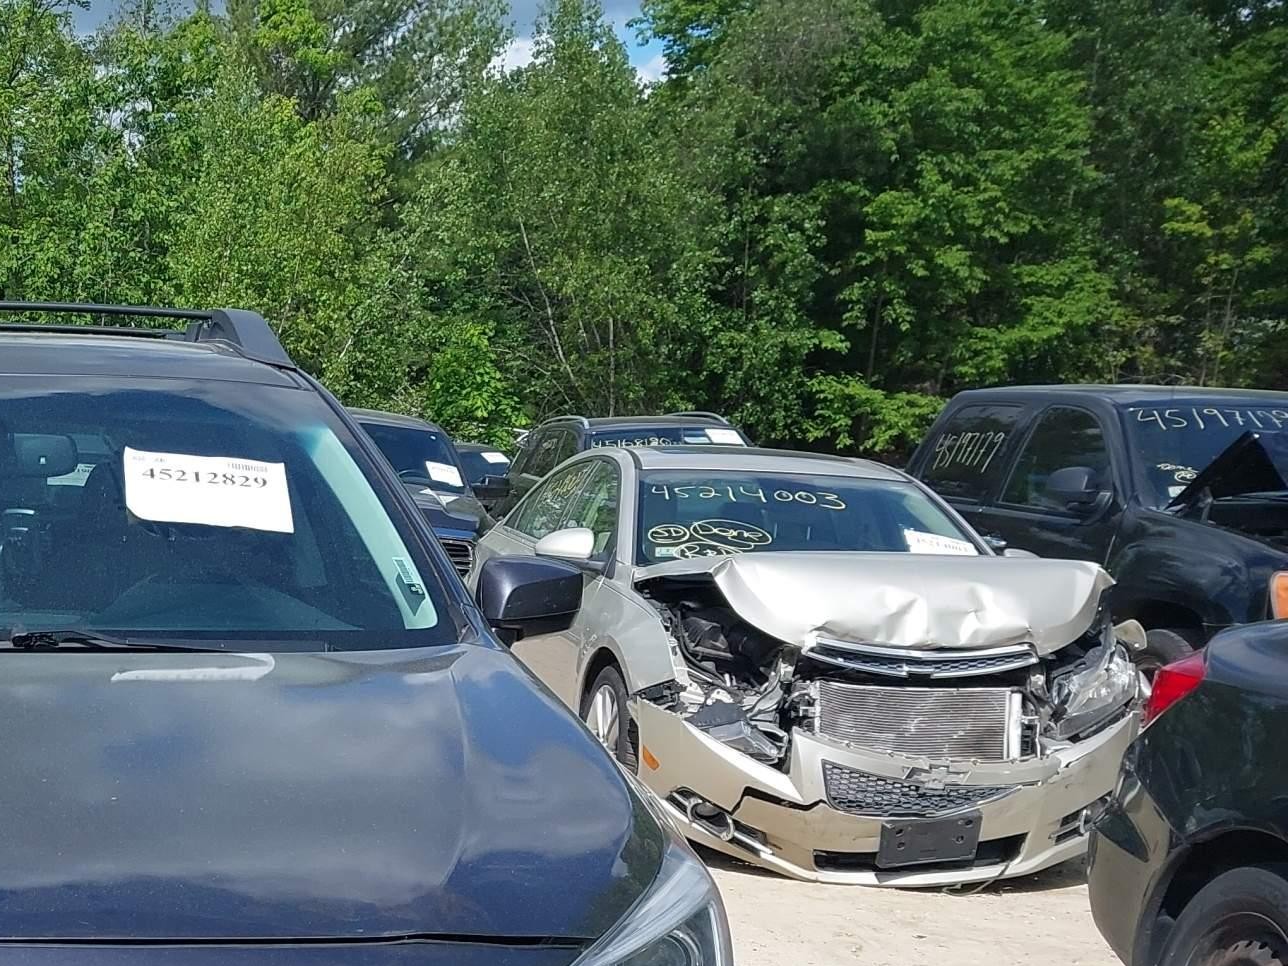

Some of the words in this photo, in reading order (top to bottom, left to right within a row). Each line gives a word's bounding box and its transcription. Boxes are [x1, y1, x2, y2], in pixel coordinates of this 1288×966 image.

[932, 431, 1006, 473] 45197179
[142, 467, 268, 488] 45212829
[651, 485, 847, 510] 45214003
[694, 521, 764, 541] Done
